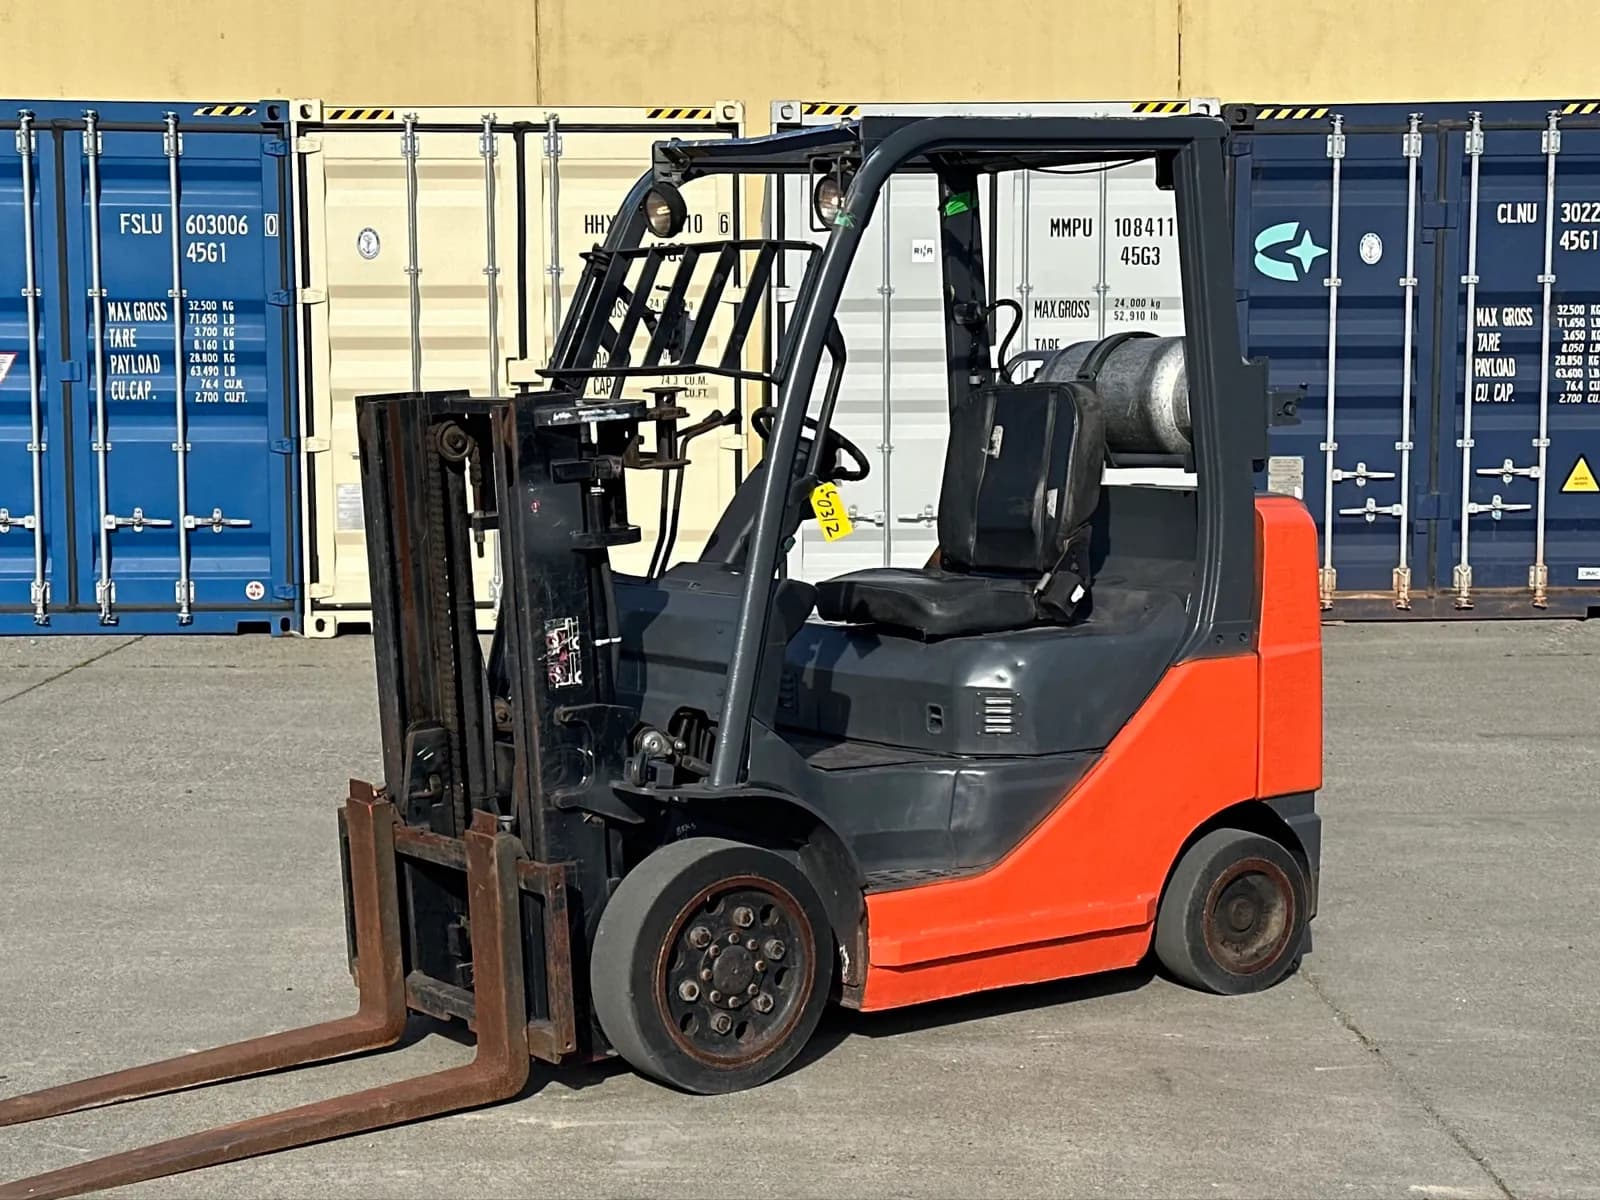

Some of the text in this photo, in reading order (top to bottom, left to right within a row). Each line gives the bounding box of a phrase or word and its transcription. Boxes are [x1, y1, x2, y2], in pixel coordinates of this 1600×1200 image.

[1497, 203, 1537, 223] CLNU
[120, 213, 278, 236] FSLU 603006 0
[720, 213, 729, 234] 6
[1050, 217, 1173, 237] MMPU 108411
[1559, 231, 1599, 250] 45G1
[186, 242, 226, 263] 45G1
[1120, 246, 1160, 266] 45G3
[107, 301, 168, 322] MAX GROSS
[188, 300, 234, 311] 32.500 KG
[1114, 297, 1161, 309] 24,000 kg
[189, 313, 235, 324] 71.650 LB
[1114, 310, 1146, 322] 52,910
[1476, 307, 1533, 327] MAX GROSS
[109, 328, 137, 348] TARE
[194, 327, 235, 337] 3.700 KG
[223, 340, 235, 350] LB
[1477, 333, 1501, 352] TARE
[110, 354, 161, 374] PAYLOAD
[223, 353, 236, 363] KG
[1475, 358, 1515, 377] PAYLOAD
[190, 366, 236, 377] 63.490 LB
[200, 379, 219, 389] 76.4
[1475, 383, 1515, 402] CU. CAP.
[195, 392, 219, 403] 2.700
